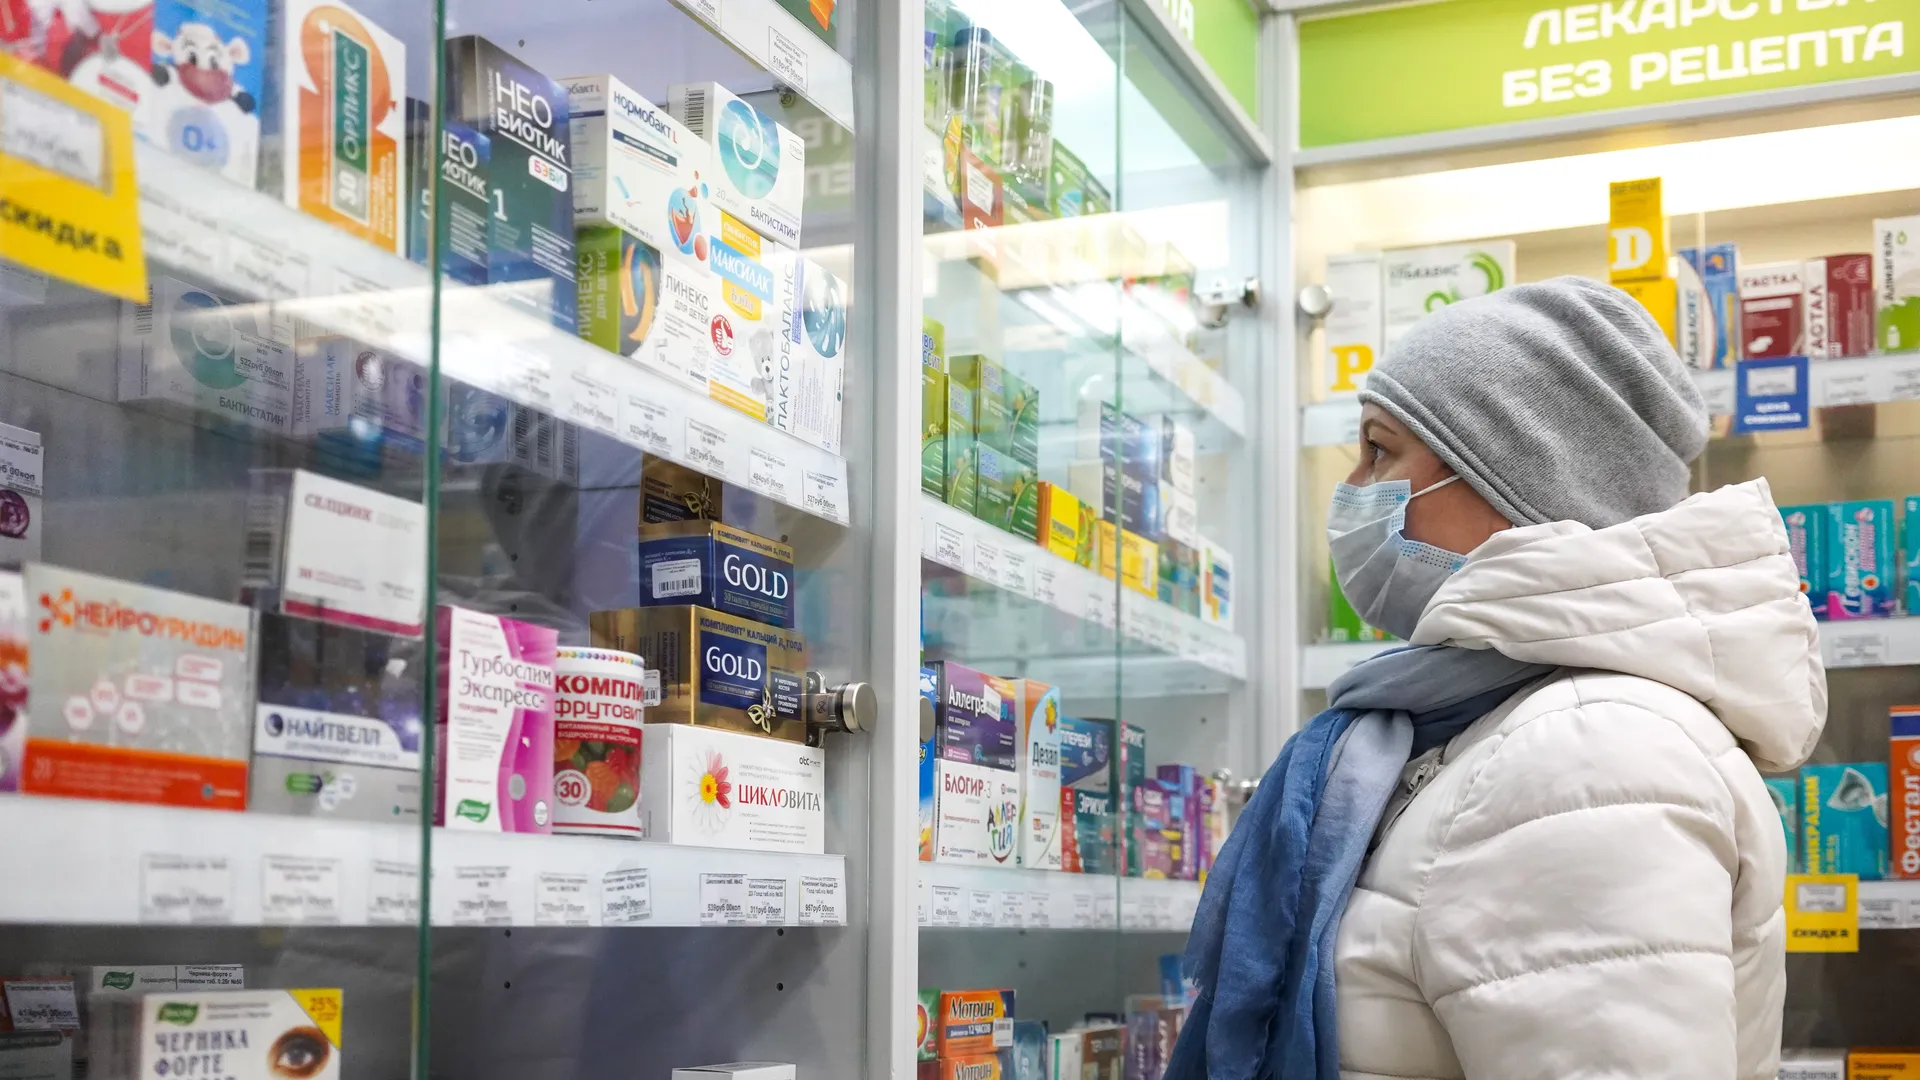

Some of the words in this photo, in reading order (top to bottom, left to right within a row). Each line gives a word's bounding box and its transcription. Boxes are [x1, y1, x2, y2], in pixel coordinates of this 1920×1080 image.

[1523, 0, 1878, 48] ЛЕКАРС
[1502, 59, 1612, 107] БЕЗ
[1630, 21, 1903, 91] РЕЦЕПТА
[495, 71, 552, 129] НЕО
[612, 90, 672, 139] нормобакт
[181, 123, 217, 153] 0+
[496, 106, 566, 164] БИОТИК
[533, 154, 566, 188] БЭБИ
[750, 205, 797, 241] БАКТИСТАТИН
[1611, 226, 1652, 271] D
[710, 245, 770, 294] МАКСИЛАК
[577, 252, 593, 337] ЛИНЕКС
[666, 274, 709, 311] ЛИНЕКС
[777, 263, 795, 430] ЛАКТОБАЛАНС
[219, 396, 284, 426] БАКТИСТАТИН
[9, 466, 36, 481] 00коп
[723, 553, 789, 600] GOLD
[74, 598, 246, 652] НЕЙРОУРИДИН
[700, 616, 744, 638] КОМПЛИВИТ
[746, 628, 778, 645] КАЛЬЦИЙ
[459, 649, 552, 686] Турбослим
[705, 646, 762, 681] GOLD
[457, 675, 545, 709] Экспресс-
[948, 683, 987, 718] Аллегра
[286, 717, 381, 746] НАЙТВЕЛЛ
[557, 730, 599, 740] БОДРОСТИ
[1032, 743, 1058, 767] Дезал
[559, 780, 582, 799] 30
[738, 783, 821, 812] ЦИКЛОВИТА
[944, 773, 992, 799] БЛОГИР-3
[1901, 772, 1920, 874] Фестал
[1792, 927, 1849, 939] скидка
[948, 995, 996, 1020] Мотрин
[155, 1029, 249, 1053] ЧЕРНИКА
[967, 1025, 975, 1035] 12
[154, 1053, 224, 1078] ФОРТЕ
